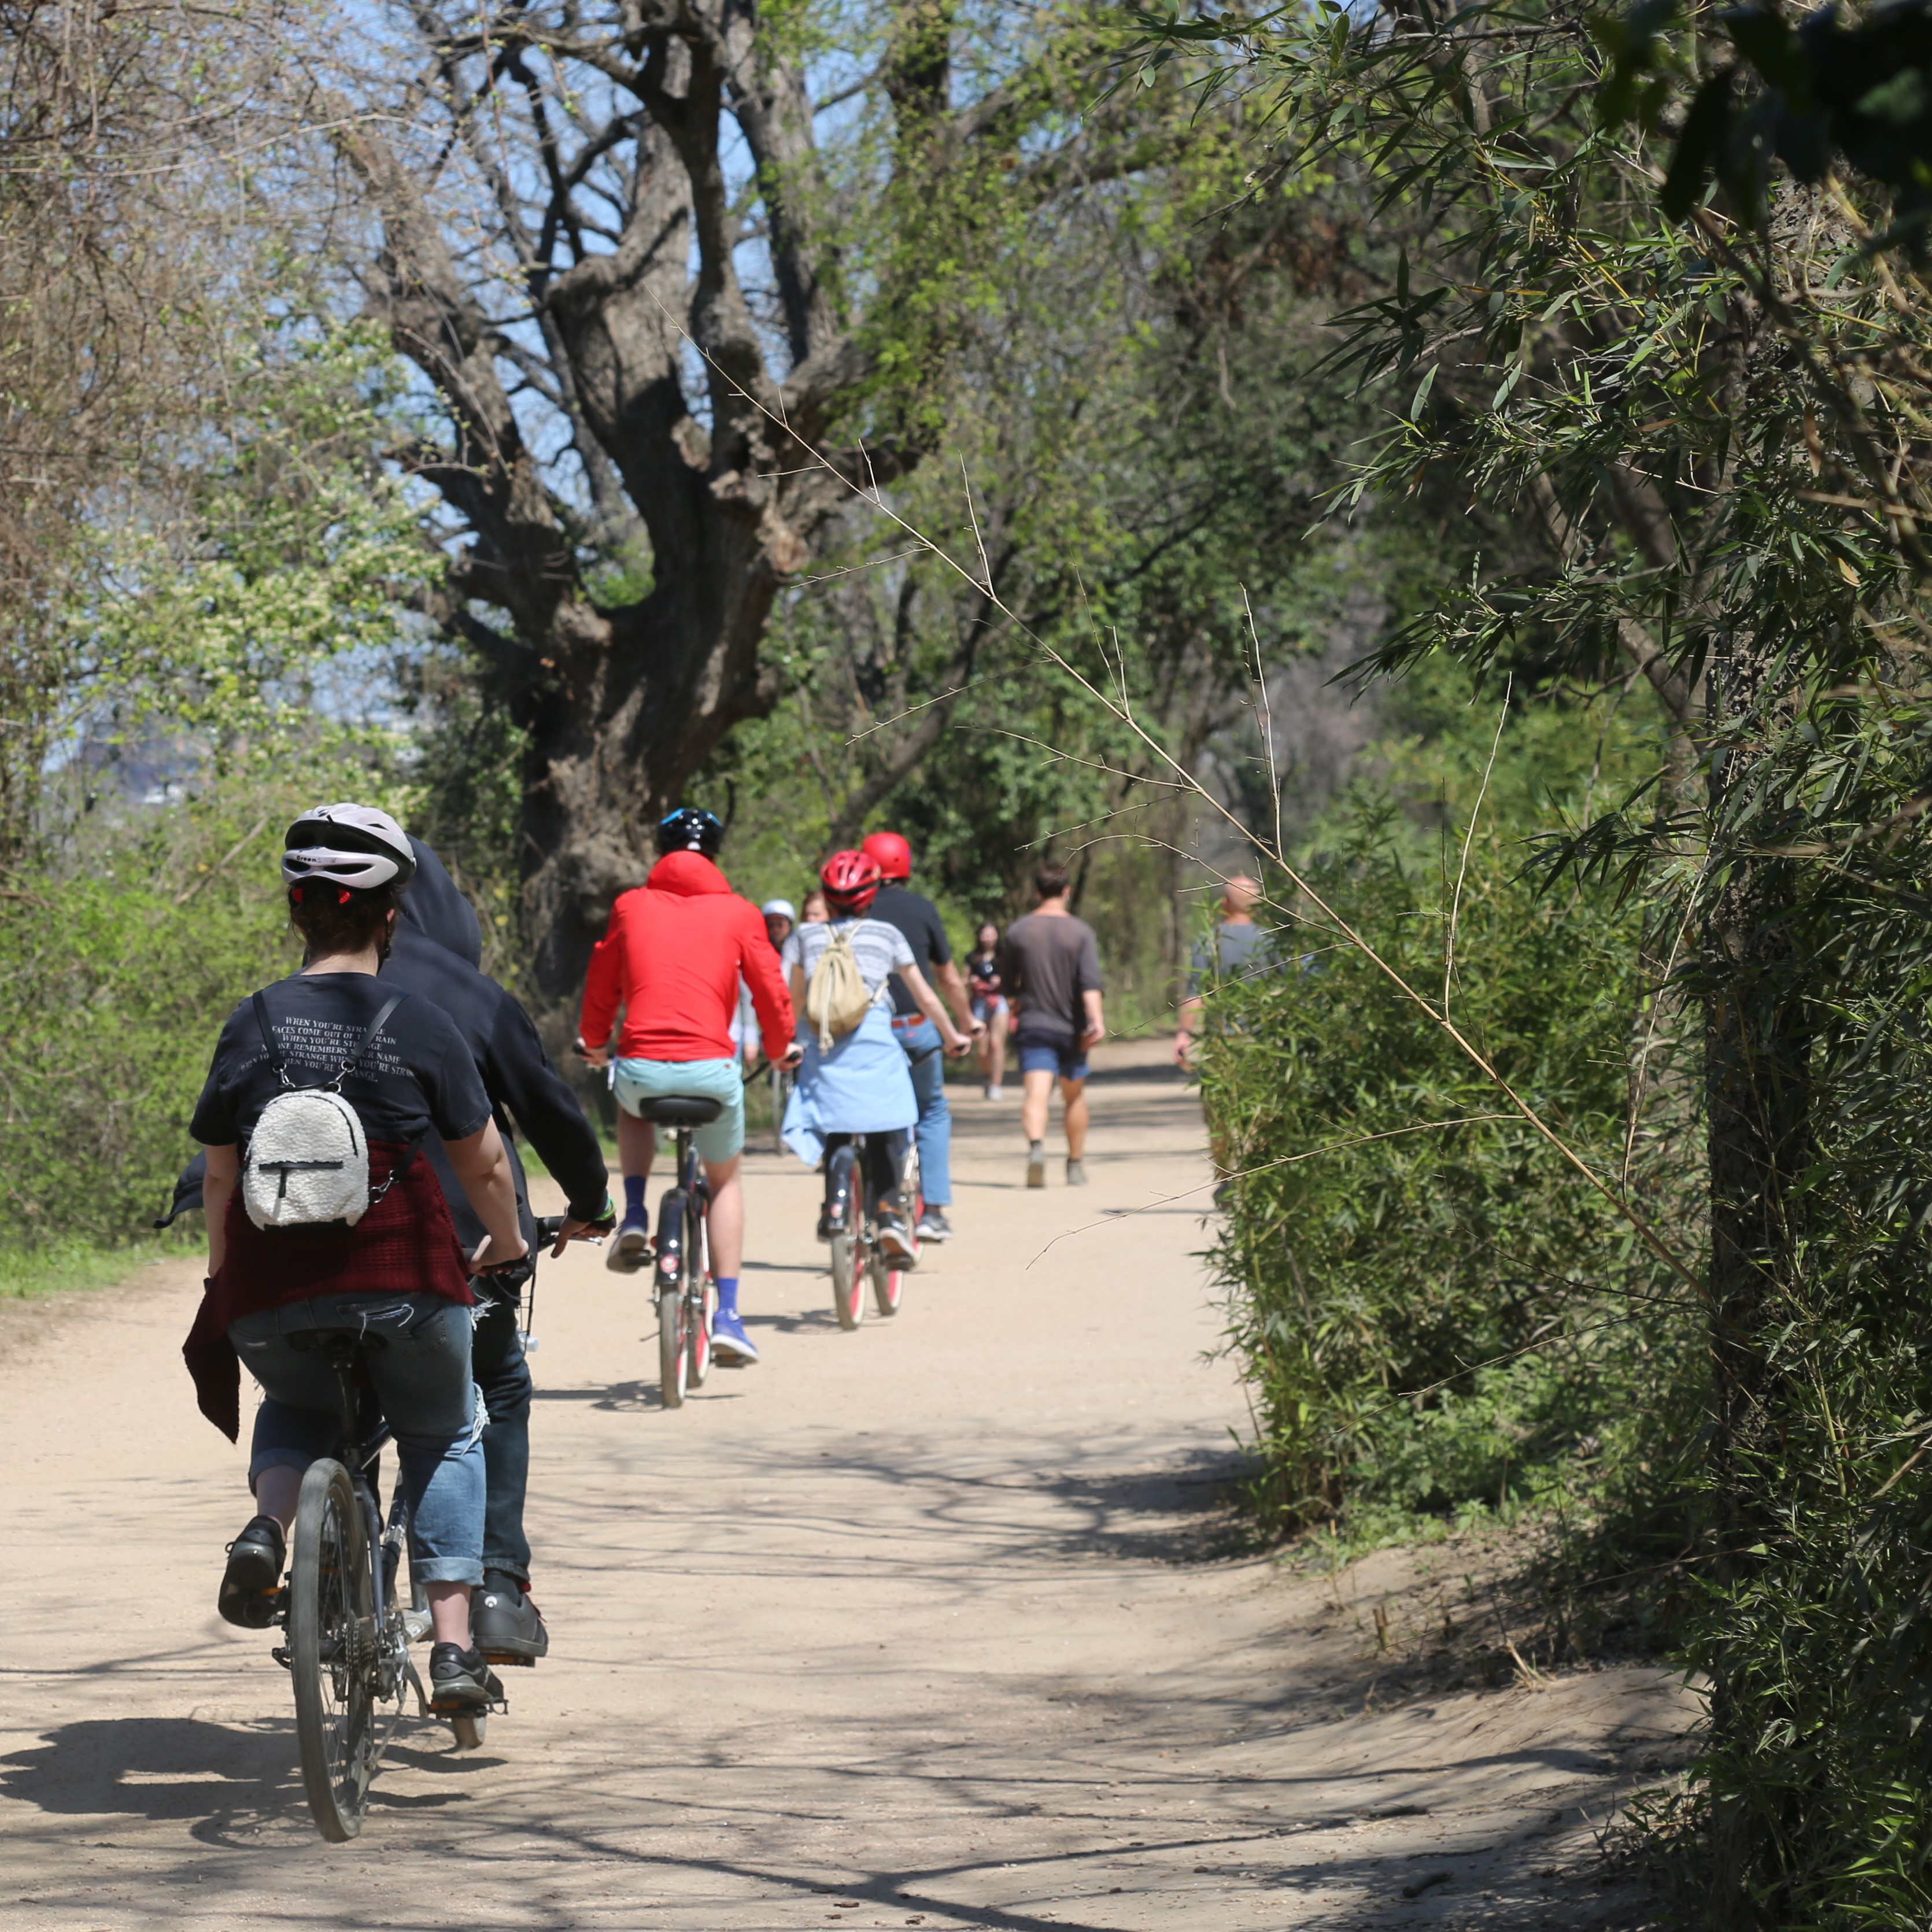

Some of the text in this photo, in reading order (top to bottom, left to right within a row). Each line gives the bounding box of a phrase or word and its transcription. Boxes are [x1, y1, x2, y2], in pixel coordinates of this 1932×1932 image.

[286, 1017, 311, 1026] WHEN
[313, 1020, 343, 1031] YOU'RE
[272, 1026, 295, 1034] FACES
[297, 1027, 322, 1036] COME
[324, 1030, 341, 1039] OUT
[375, 1036, 397, 1044] RAIN
[282, 1034, 307, 1043] WHEN
[309, 1037, 341, 1046] YOU'RE
[289, 1051, 328, 1062] STRANGE
[359, 1059, 390, 1073] YOU'RE
[293, 1044, 348, 1055] REMEMBERS
[376, 1052, 402, 1064] NAME
[304, 1060, 335, 1072] YOU'RE
